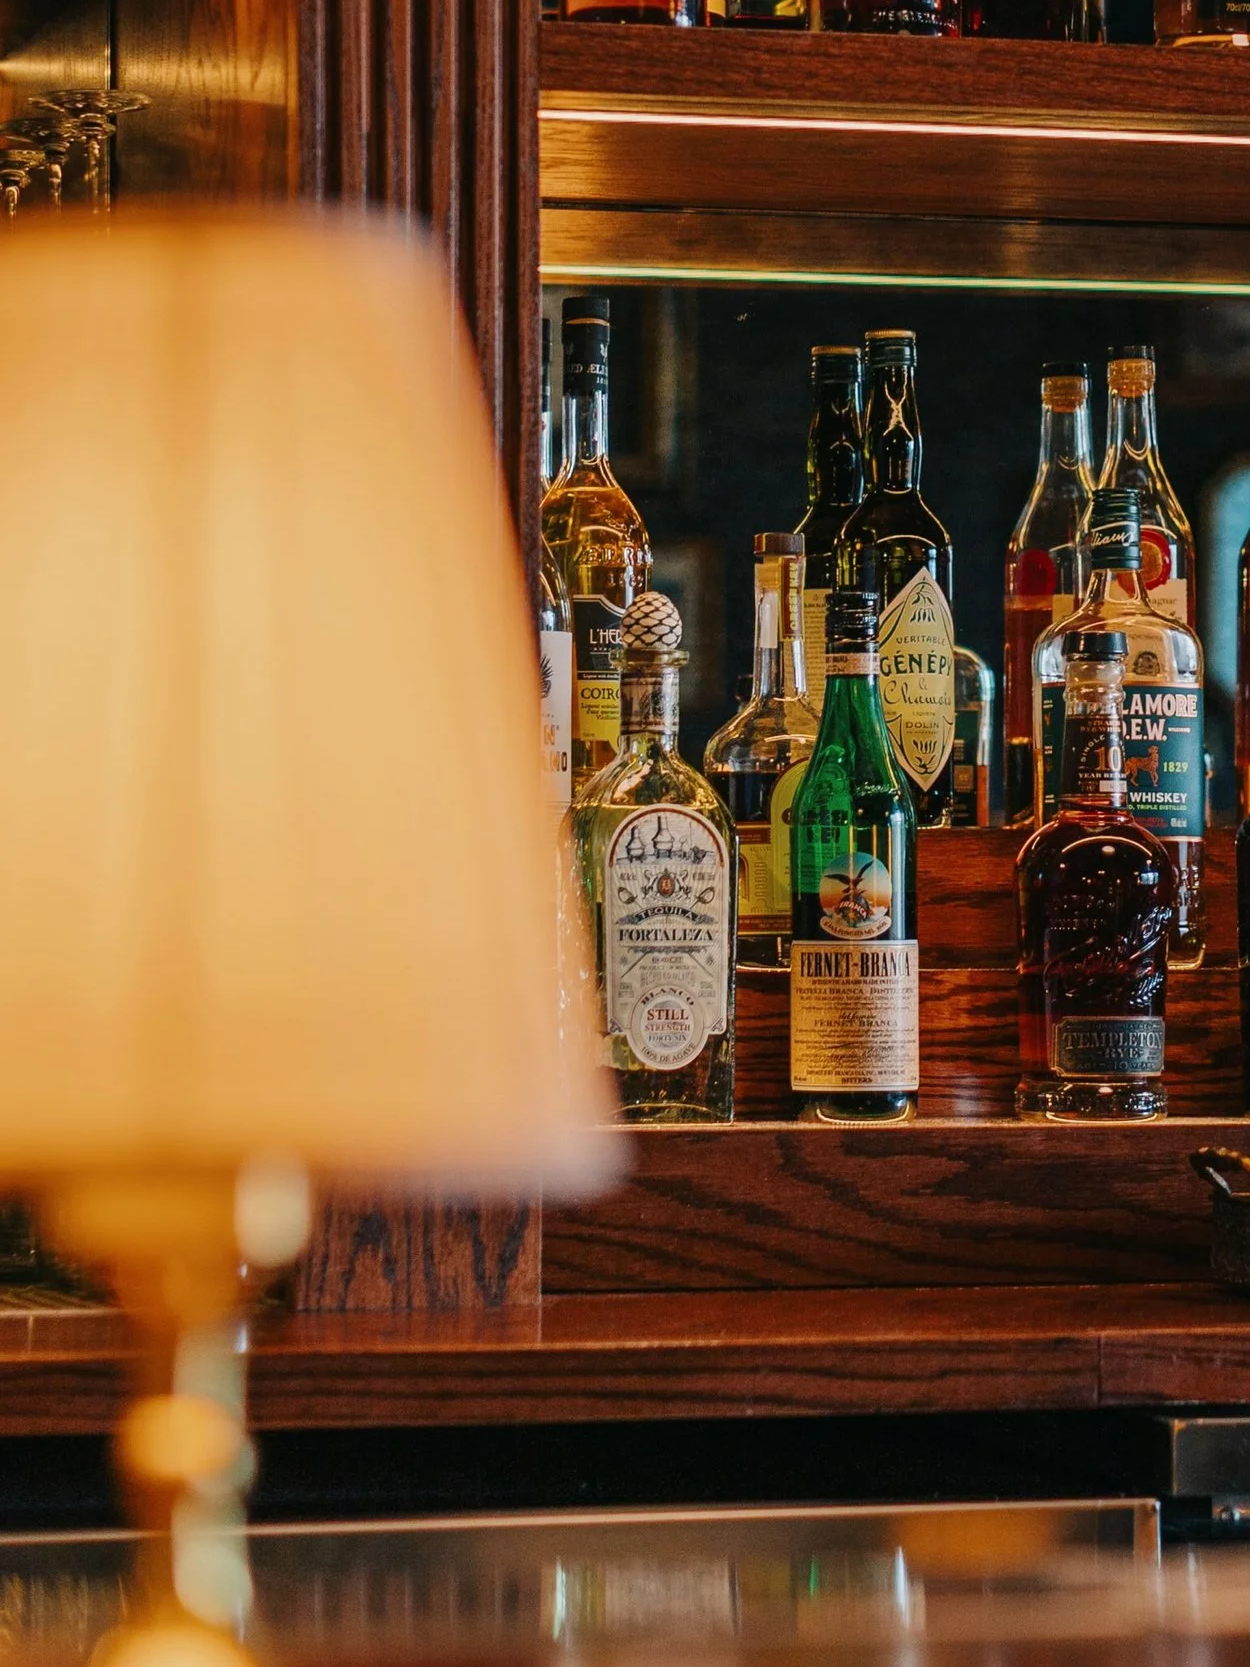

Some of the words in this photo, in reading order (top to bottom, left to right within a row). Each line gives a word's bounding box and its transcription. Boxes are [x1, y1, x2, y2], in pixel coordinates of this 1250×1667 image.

[896, 634, 946, 646] VERITABLE
[880, 650, 952, 676] GÉNÉPY
[884, 680, 951, 707] Chamois
[1120, 693, 1198, 718] LAMORE
[905, 721, 940, 729] DOLIN
[1094, 745, 1122, 772] 10
[1163, 761, 1189, 773] 1829
[1130, 791, 1188, 804] WHISKEY
[640, 906, 694, 920] TEQUILA
[619, 928, 713, 942] FORTALEZA
[641, 987, 695, 1007] BLANCO
[829, 987, 864, 995] BRANCA
[646, 1008, 689, 1021] STILL
[645, 1023, 691, 1032] STRENGTH
[648, 1034, 672, 1042] FORTY
[674, 1034, 687, 1042] SIX
[1063, 1032, 1162, 1050] TEMPLETON
[659, 1055, 670, 1063] DE
[672, 1043, 697, 1063] AGAVE
[1104, 1048, 1139, 1059] RYE
